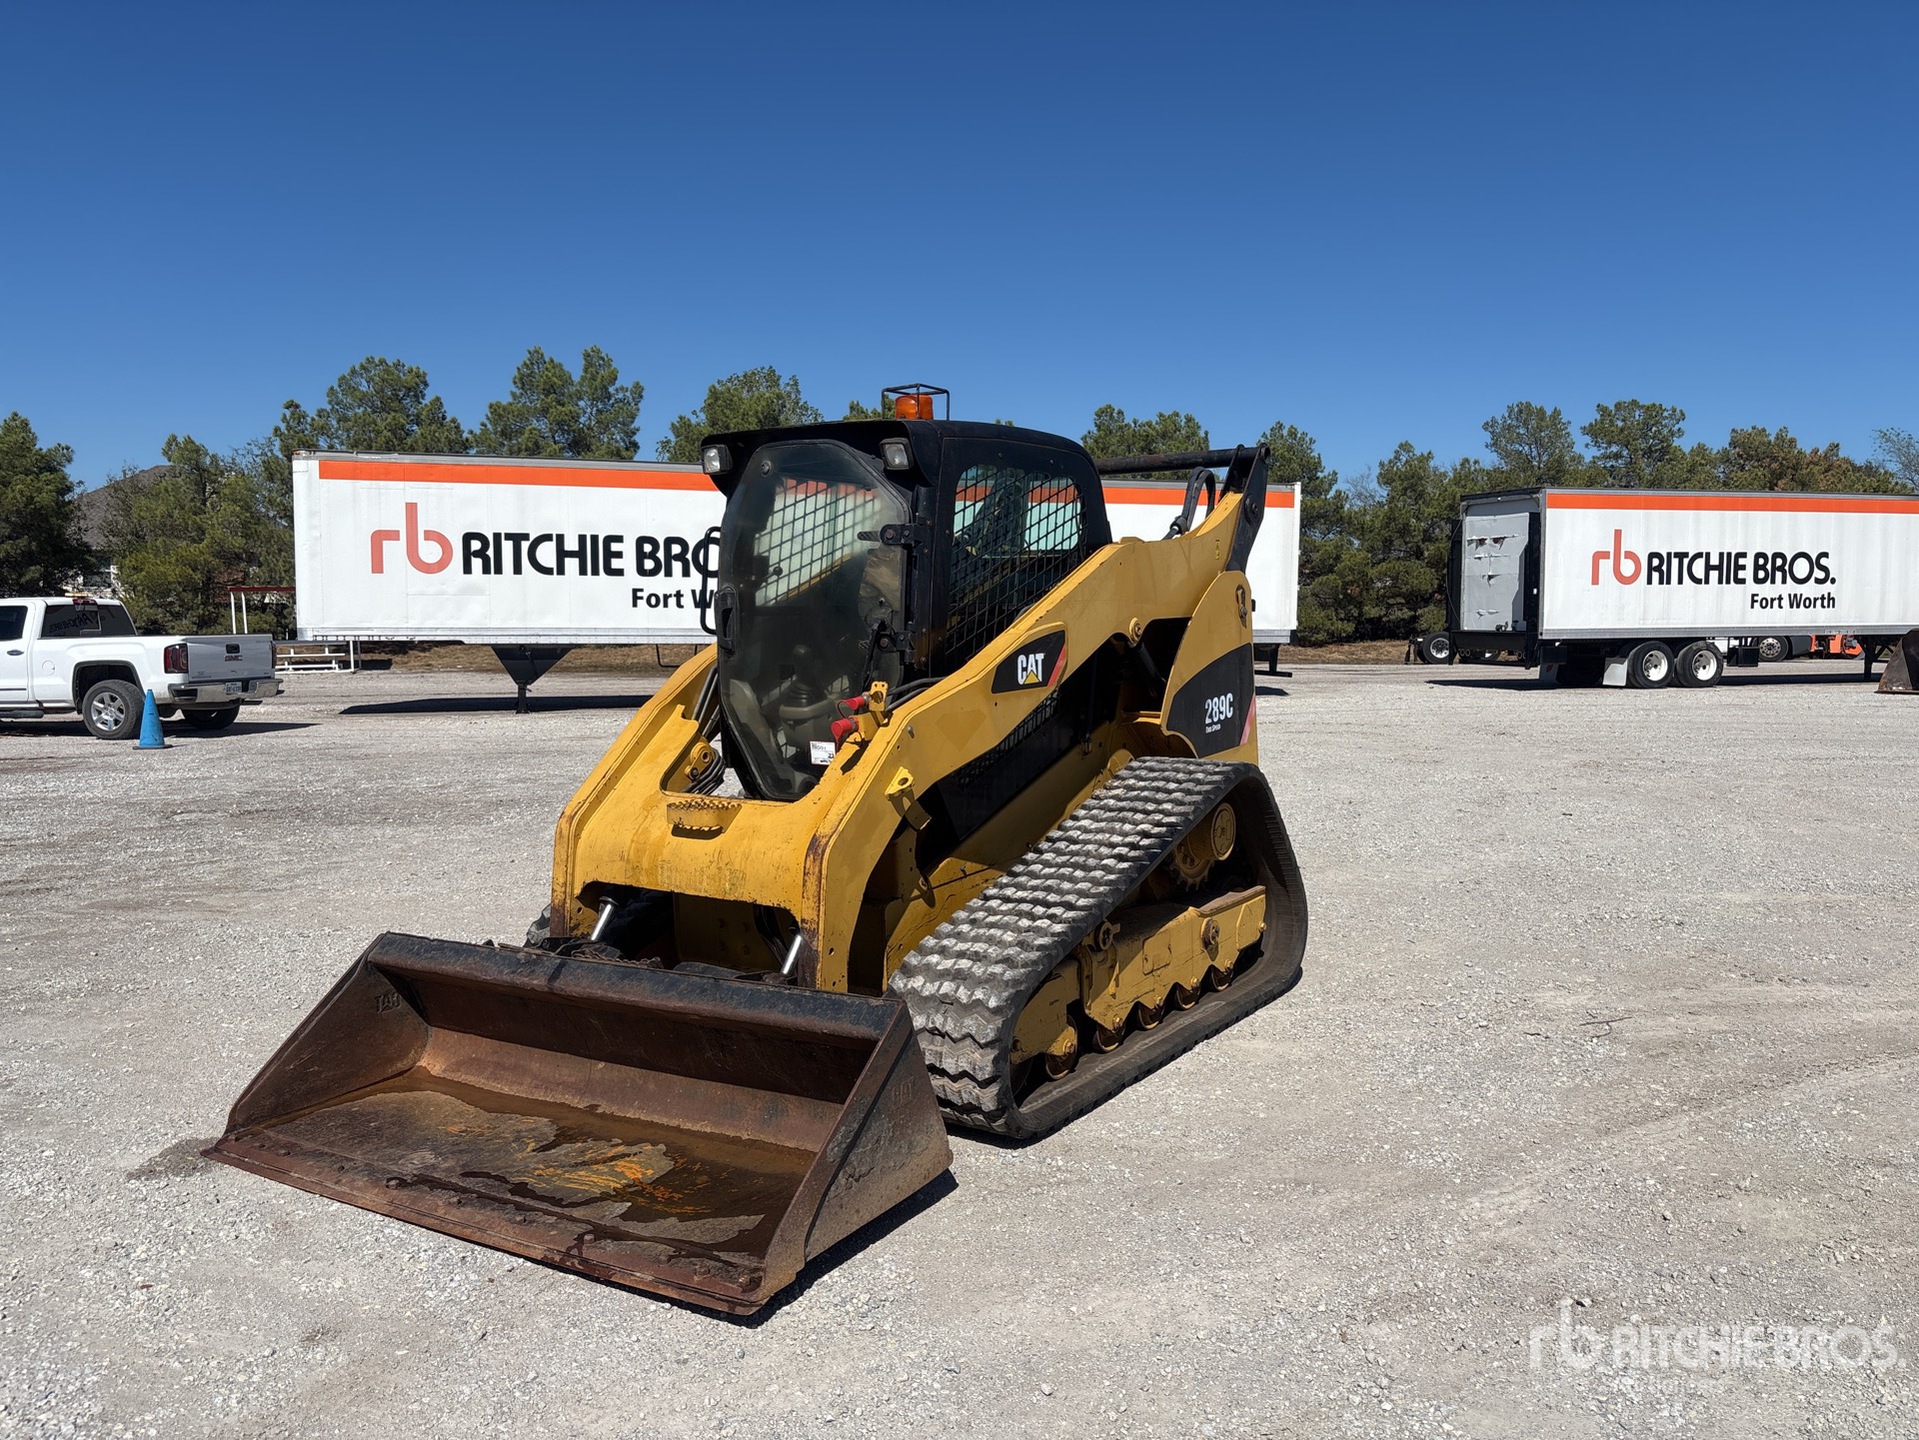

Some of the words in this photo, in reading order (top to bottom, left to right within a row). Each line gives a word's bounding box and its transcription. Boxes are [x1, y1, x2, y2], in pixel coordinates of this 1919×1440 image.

[371, 502, 453, 574] rb
[462, 531, 625, 577] RITCHIE
[635, 535, 721, 578] BRO
[1591, 529, 1642, 585] rb
[1646, 551, 1748, 585] RITCHIE
[1753, 551, 1837, 585] BROS.
[632, 588, 684, 608] Fort
[1750, 593, 1784, 609] Fort
[1788, 592, 1836, 609] Worth
[1017, 653, 1045, 685] CAT
[1204, 692, 1234, 724] 289C
